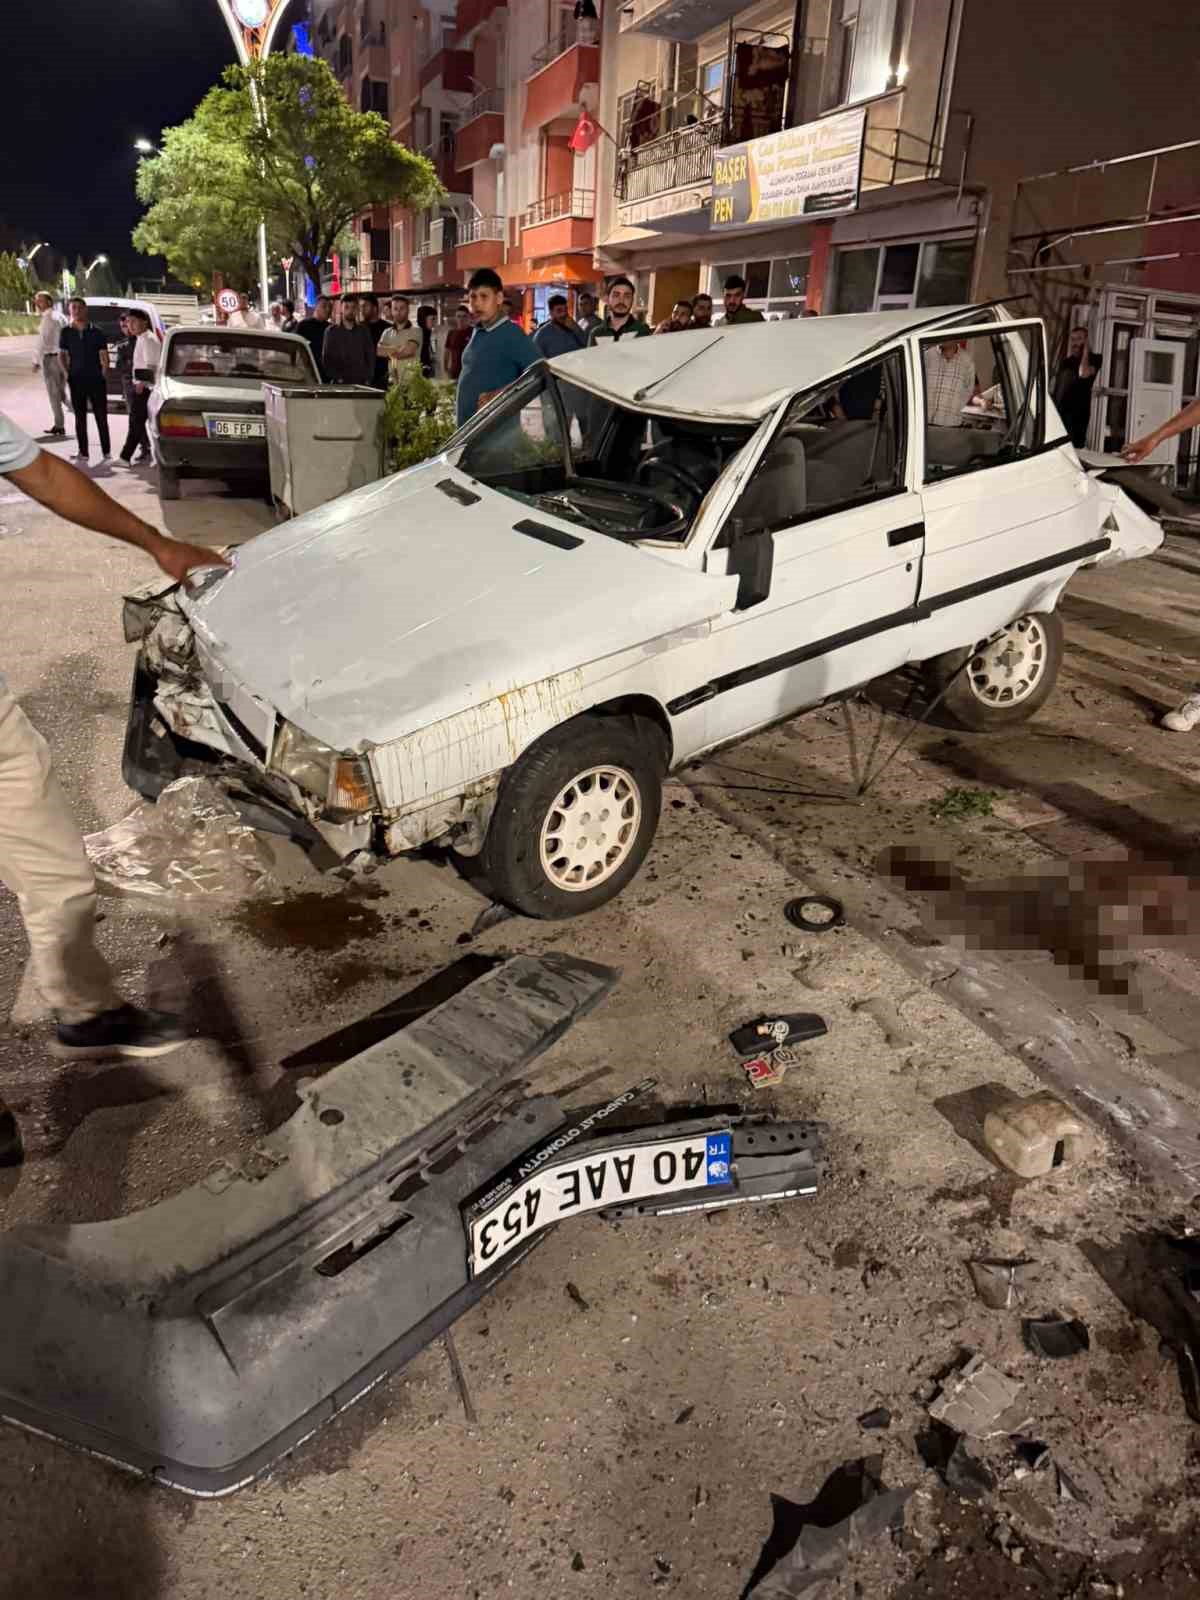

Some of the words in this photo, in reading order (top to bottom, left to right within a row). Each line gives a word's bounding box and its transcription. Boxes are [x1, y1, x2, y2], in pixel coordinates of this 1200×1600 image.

[714, 196, 734, 224] PEN
[221, 296, 237, 308] 50
[216, 422, 229, 434] 06
[234, 423, 252, 434] FEP
[579, 1092, 635, 1131] CANPOLAT
[653, 1146, 706, 1185] 40
[708, 1143, 727, 1156] TR
[556, 1154, 636, 1211] AAE
[479, 1187, 542, 1260] 453
